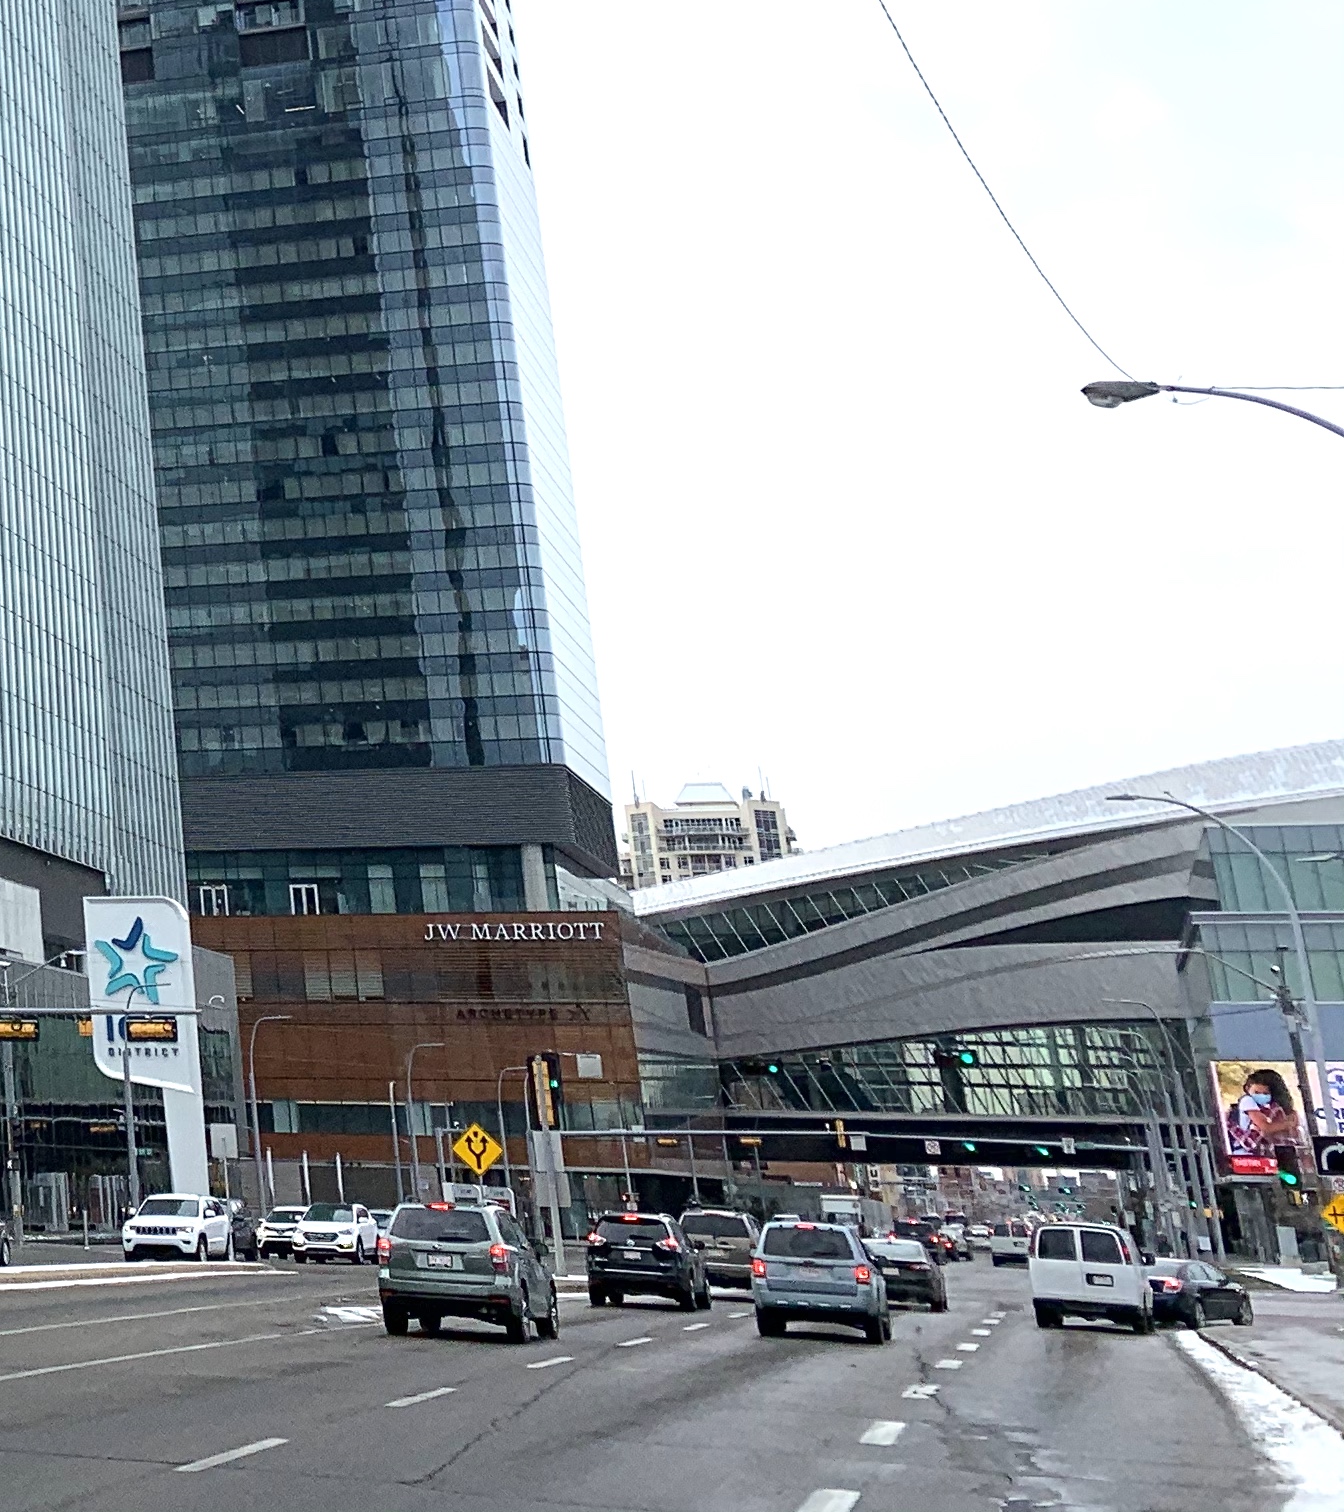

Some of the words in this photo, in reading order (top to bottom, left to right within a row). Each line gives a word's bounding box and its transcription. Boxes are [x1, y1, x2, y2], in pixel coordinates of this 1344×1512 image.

[424, 923, 461, 940] JW
[470, 922, 604, 940] MARRIOTT
[456, 1007, 559, 1021] ARCHETYPE
